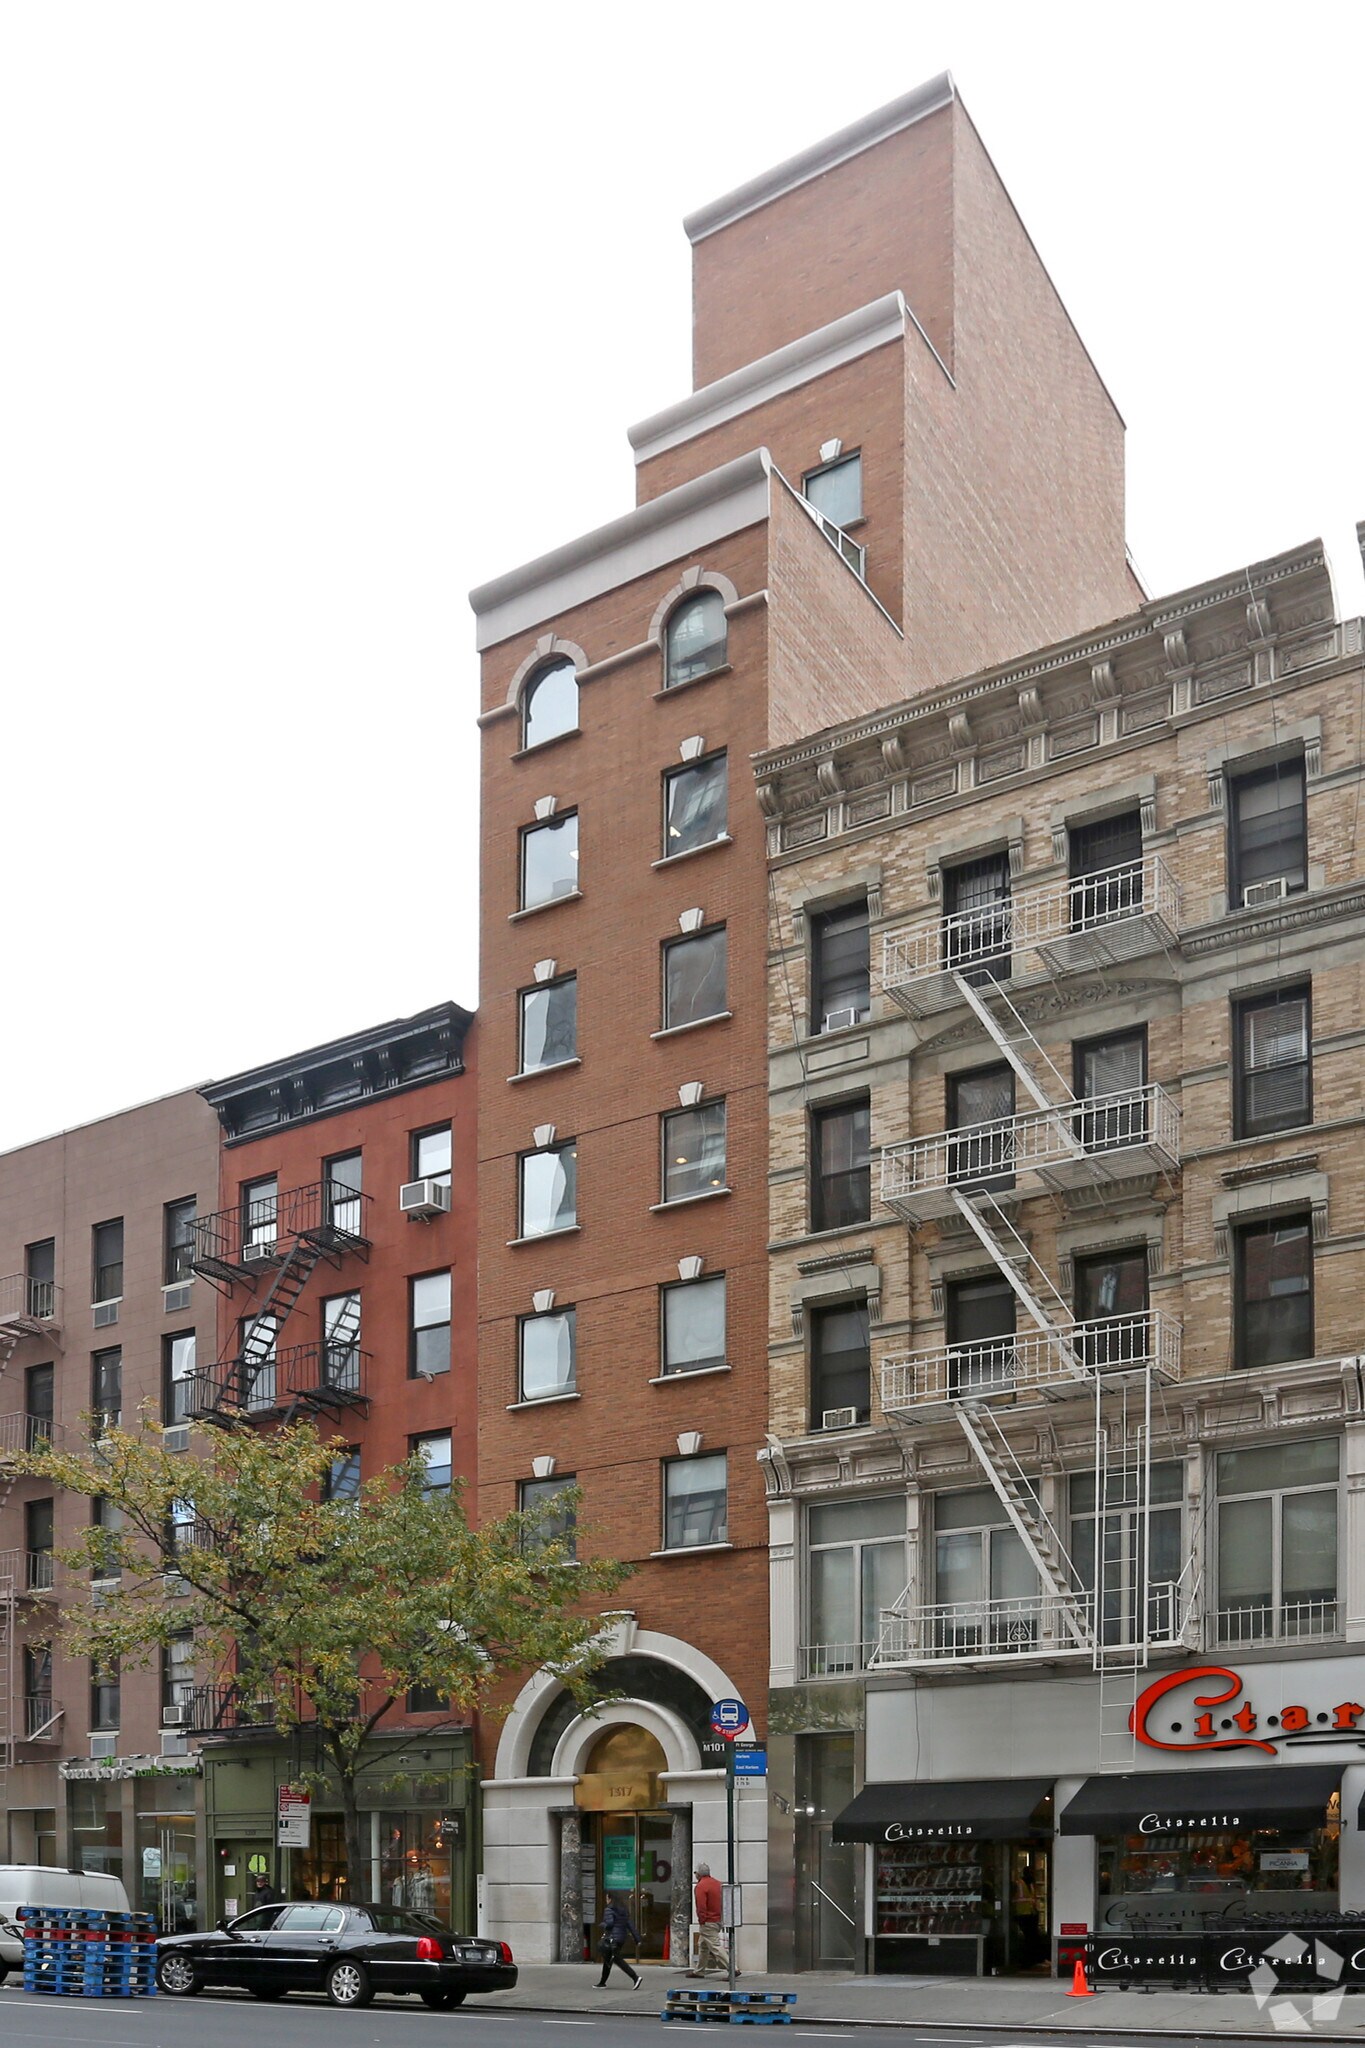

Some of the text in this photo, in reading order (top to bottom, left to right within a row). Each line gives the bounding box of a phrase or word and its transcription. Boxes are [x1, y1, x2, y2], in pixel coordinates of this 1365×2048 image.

[703, 1743, 725, 1752] M101
[884, 1822, 973, 1842] Citarella
[1138, 1813, 1240, 1834] Citarella
[1098, 1947, 1196, 1970] Citarella
[1220, 1947, 1326, 1971] Citarella
